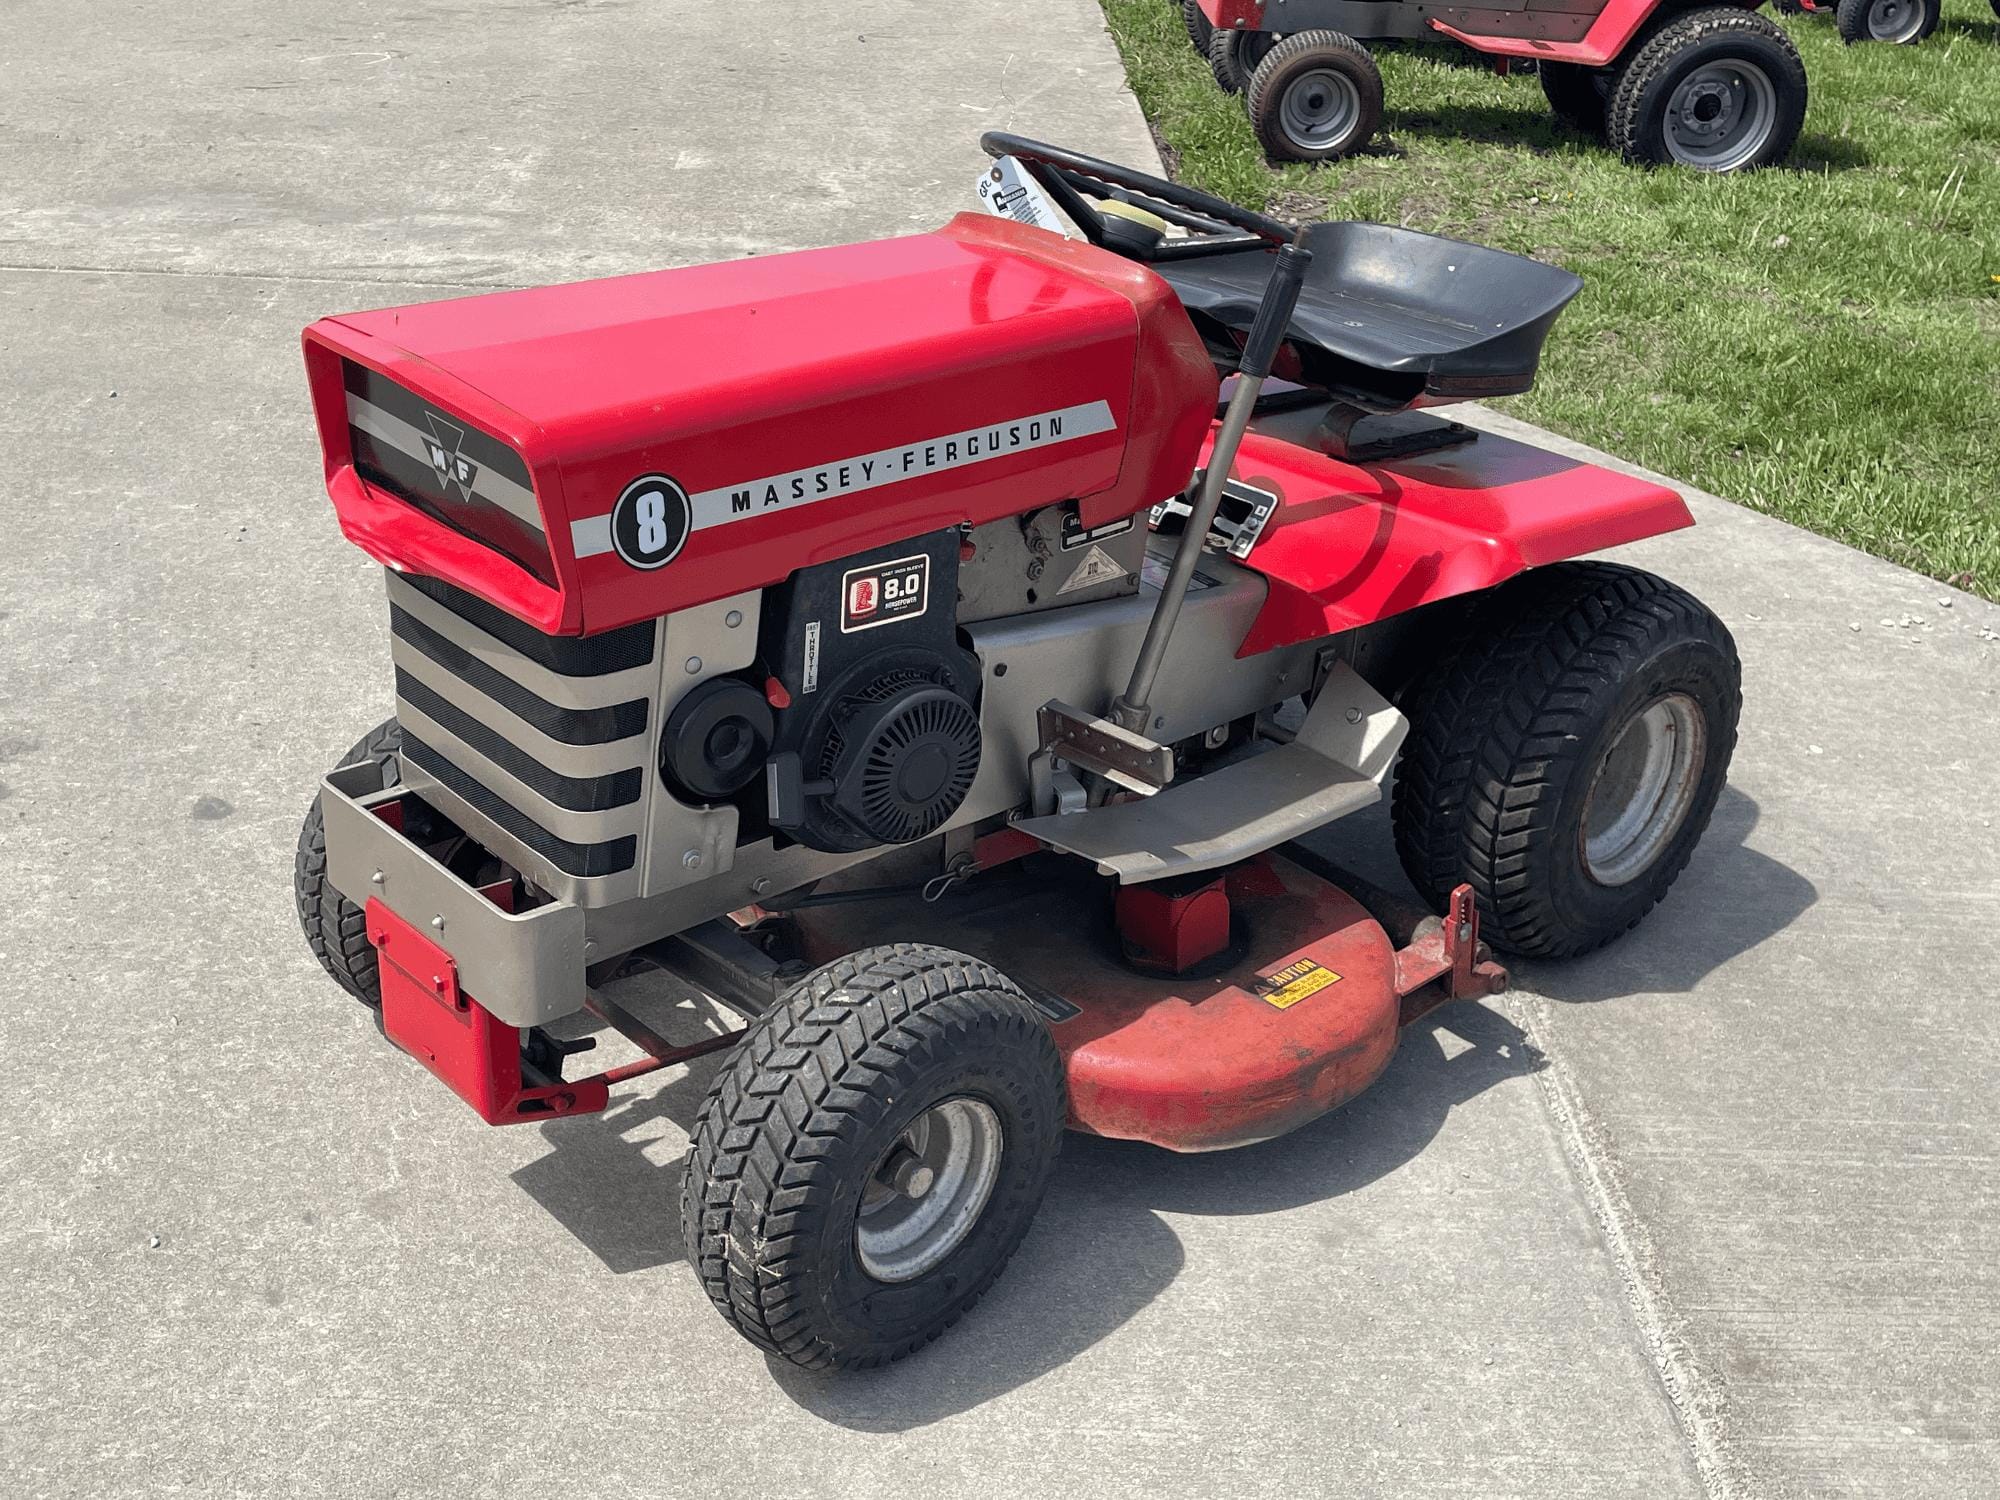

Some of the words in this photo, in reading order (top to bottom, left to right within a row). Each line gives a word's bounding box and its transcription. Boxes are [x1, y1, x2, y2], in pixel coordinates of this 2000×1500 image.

[635, 490, 668, 555] 8
[884, 573, 920, 600] 8.0
[808, 631, 816, 685] THROTTLE
[1266, 959, 1317, 986] CAUTION
